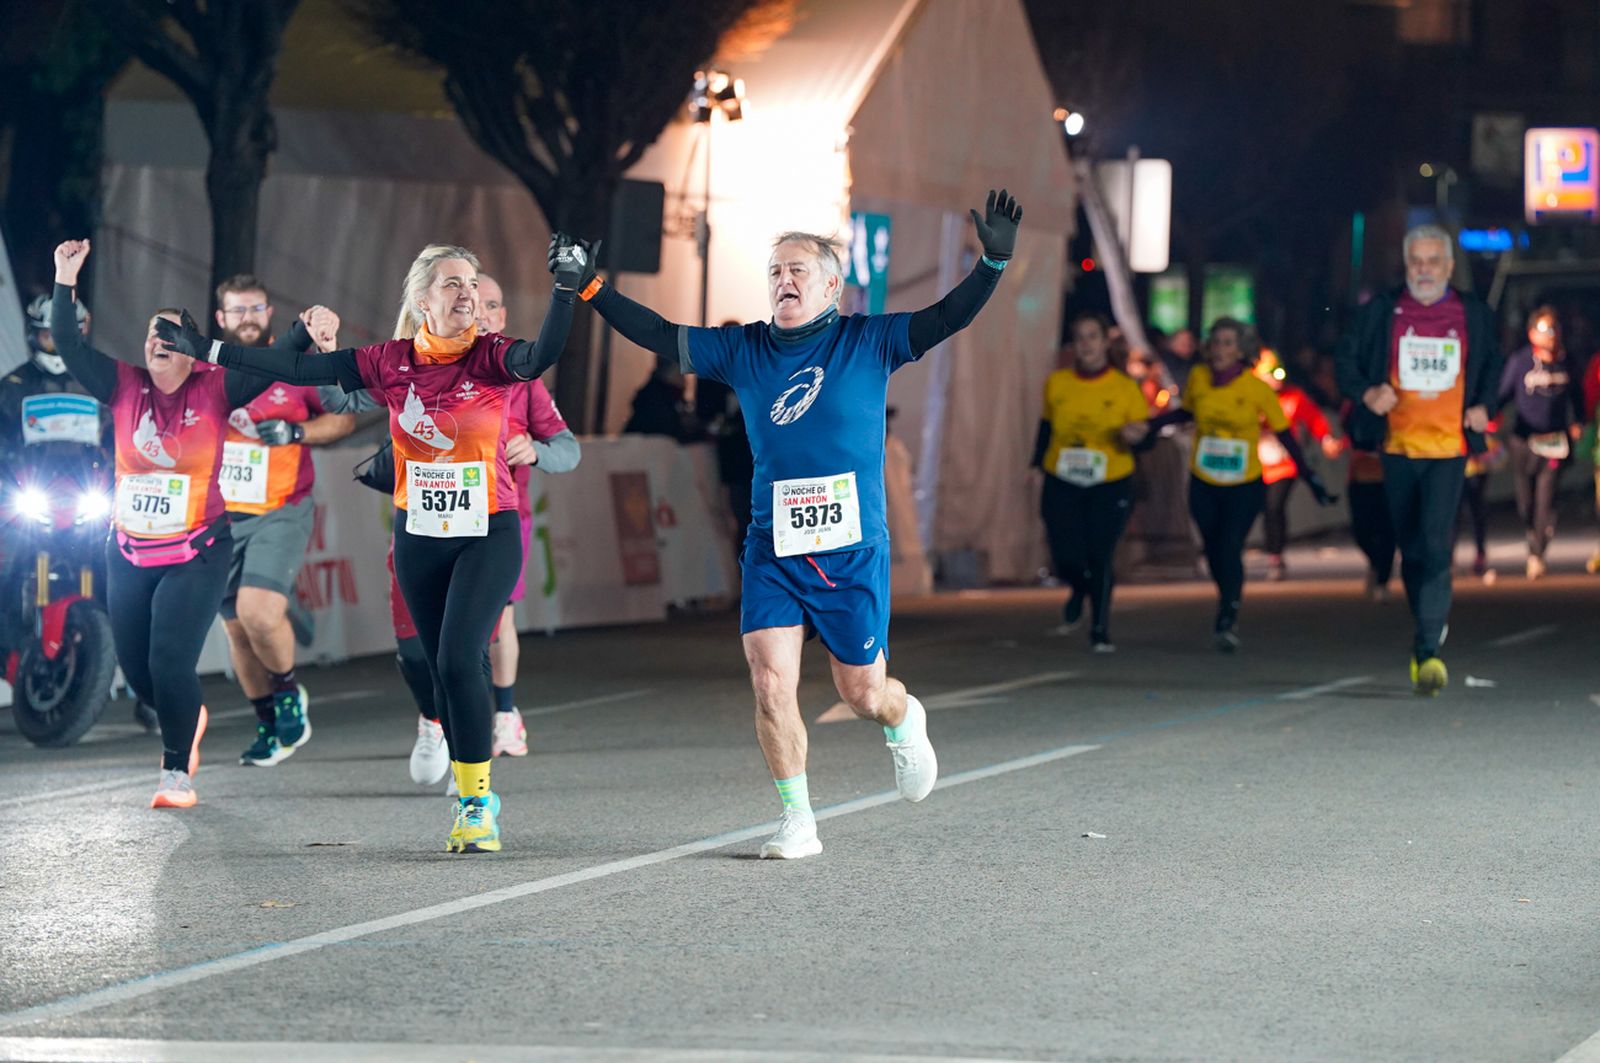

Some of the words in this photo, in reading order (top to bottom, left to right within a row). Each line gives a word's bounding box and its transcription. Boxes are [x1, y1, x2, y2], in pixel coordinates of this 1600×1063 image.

[413, 421, 435, 440] 43
[143, 441, 160, 458] 43
[414, 479, 428, 487] SAN
[422, 471, 444, 480] NOCHE
[791, 487, 816, 496] NOCHE
[132, 494, 170, 515] 5775
[422, 489, 471, 512] 5374
[783, 498, 799, 506] SAN
[790, 502, 843, 529] 5373
